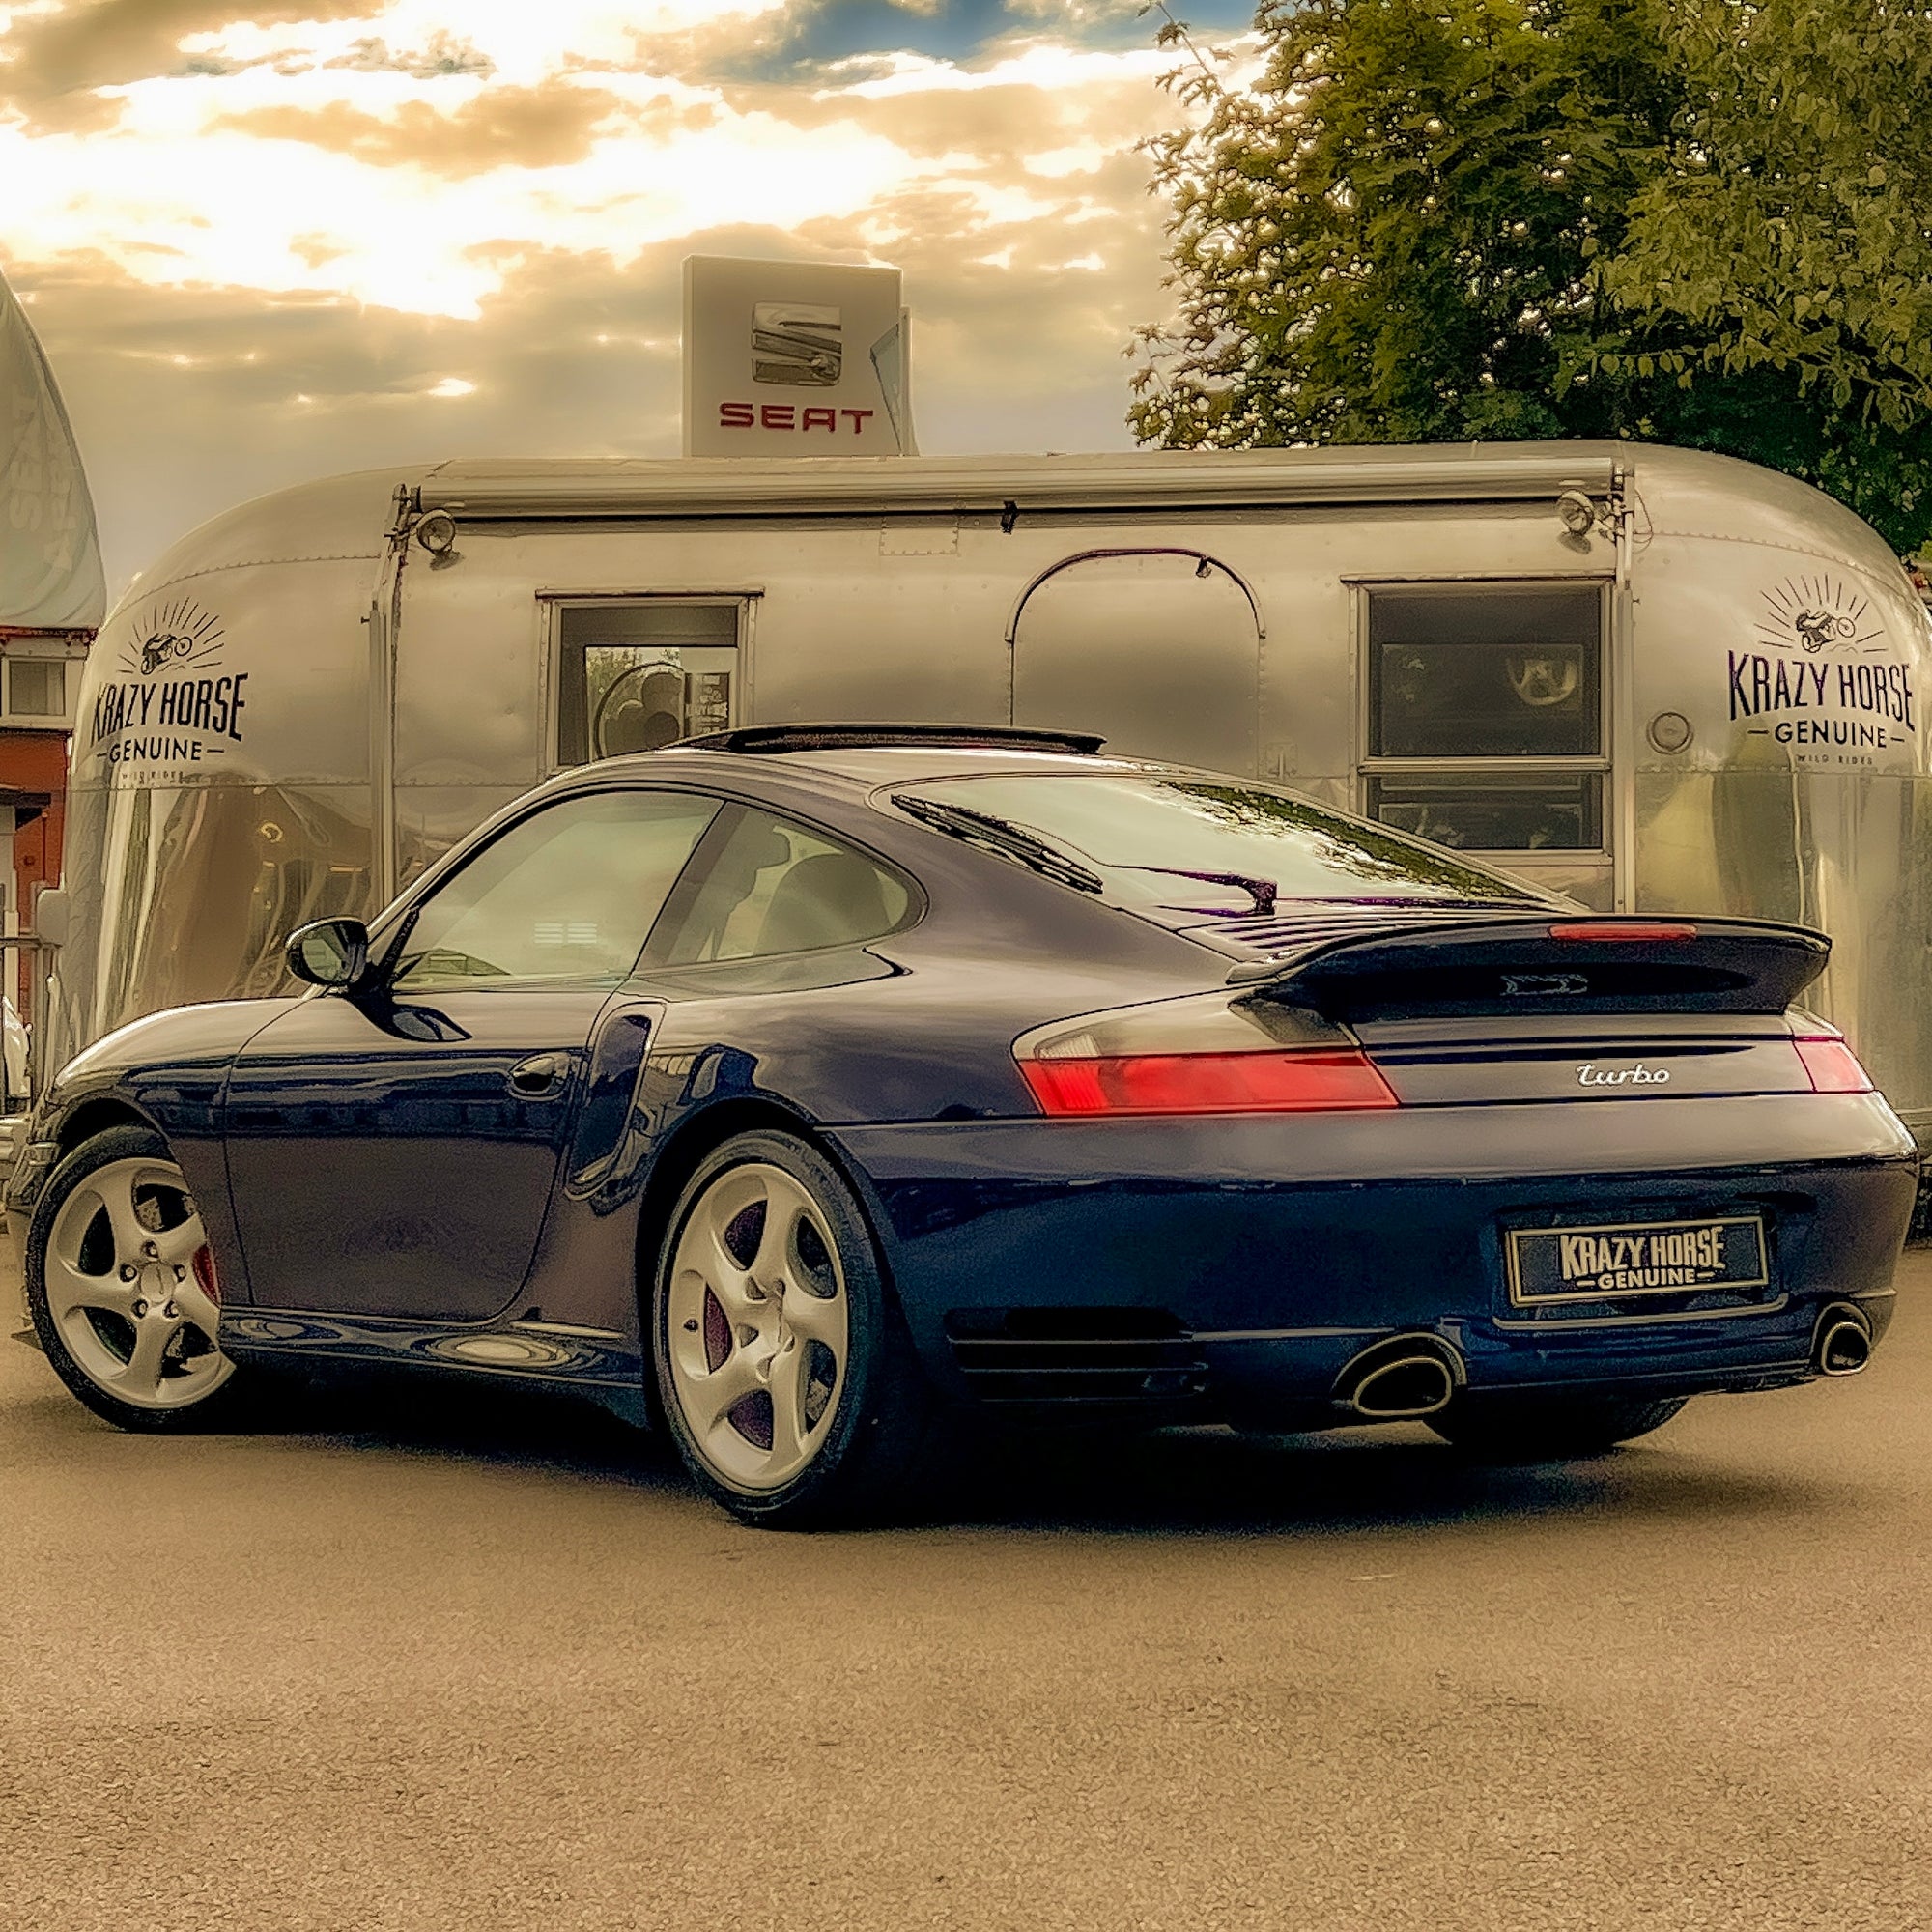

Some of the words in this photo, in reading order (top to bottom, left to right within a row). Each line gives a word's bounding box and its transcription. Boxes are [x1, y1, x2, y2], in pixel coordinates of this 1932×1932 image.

[720, 402, 873, 434] SEAT
[1728, 650, 1829, 721] KRAZY
[1837, 663, 1915, 732] HORSE
[90, 682, 156, 748] KRAZY
[159, 672, 248, 741] HORSE
[109, 737, 202, 762] GENUINE
[1775, 720, 1887, 748] GENUINE
[1560, 1235, 1644, 1280] KRAZY
[1650, 1226, 1726, 1269] HORSE
[1598, 1268, 1696, 1290] GENUINE
